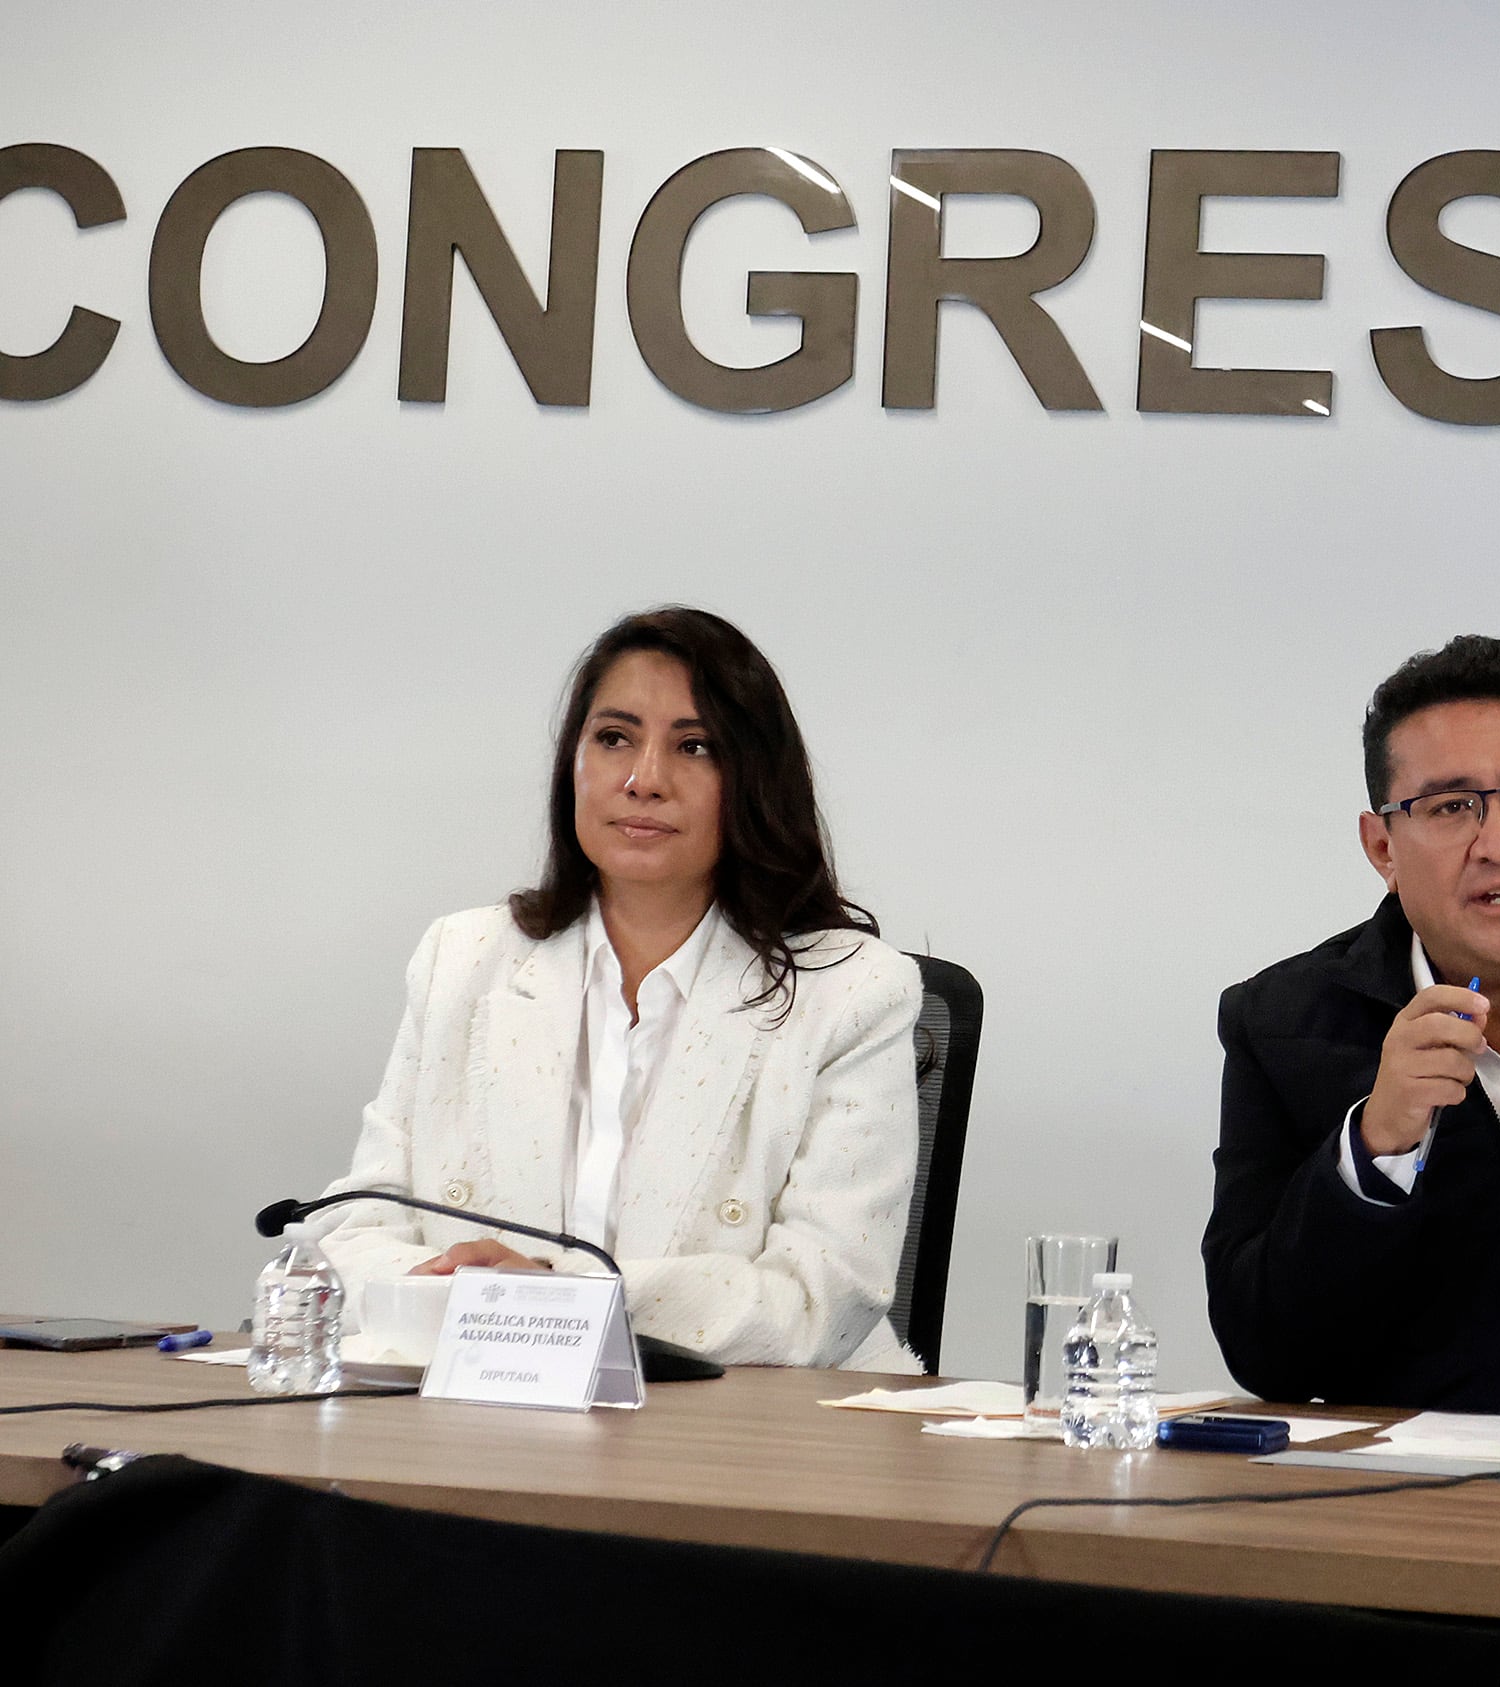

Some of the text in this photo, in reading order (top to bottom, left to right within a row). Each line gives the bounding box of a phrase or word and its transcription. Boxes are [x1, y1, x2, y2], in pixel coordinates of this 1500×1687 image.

[458, 1312, 590, 1331] ANGÉLICA PATRICIA
[459, 1329, 583, 1347] ALVARADO JUÁREZ
[479, 1369, 539, 1383] DIPUTADA
